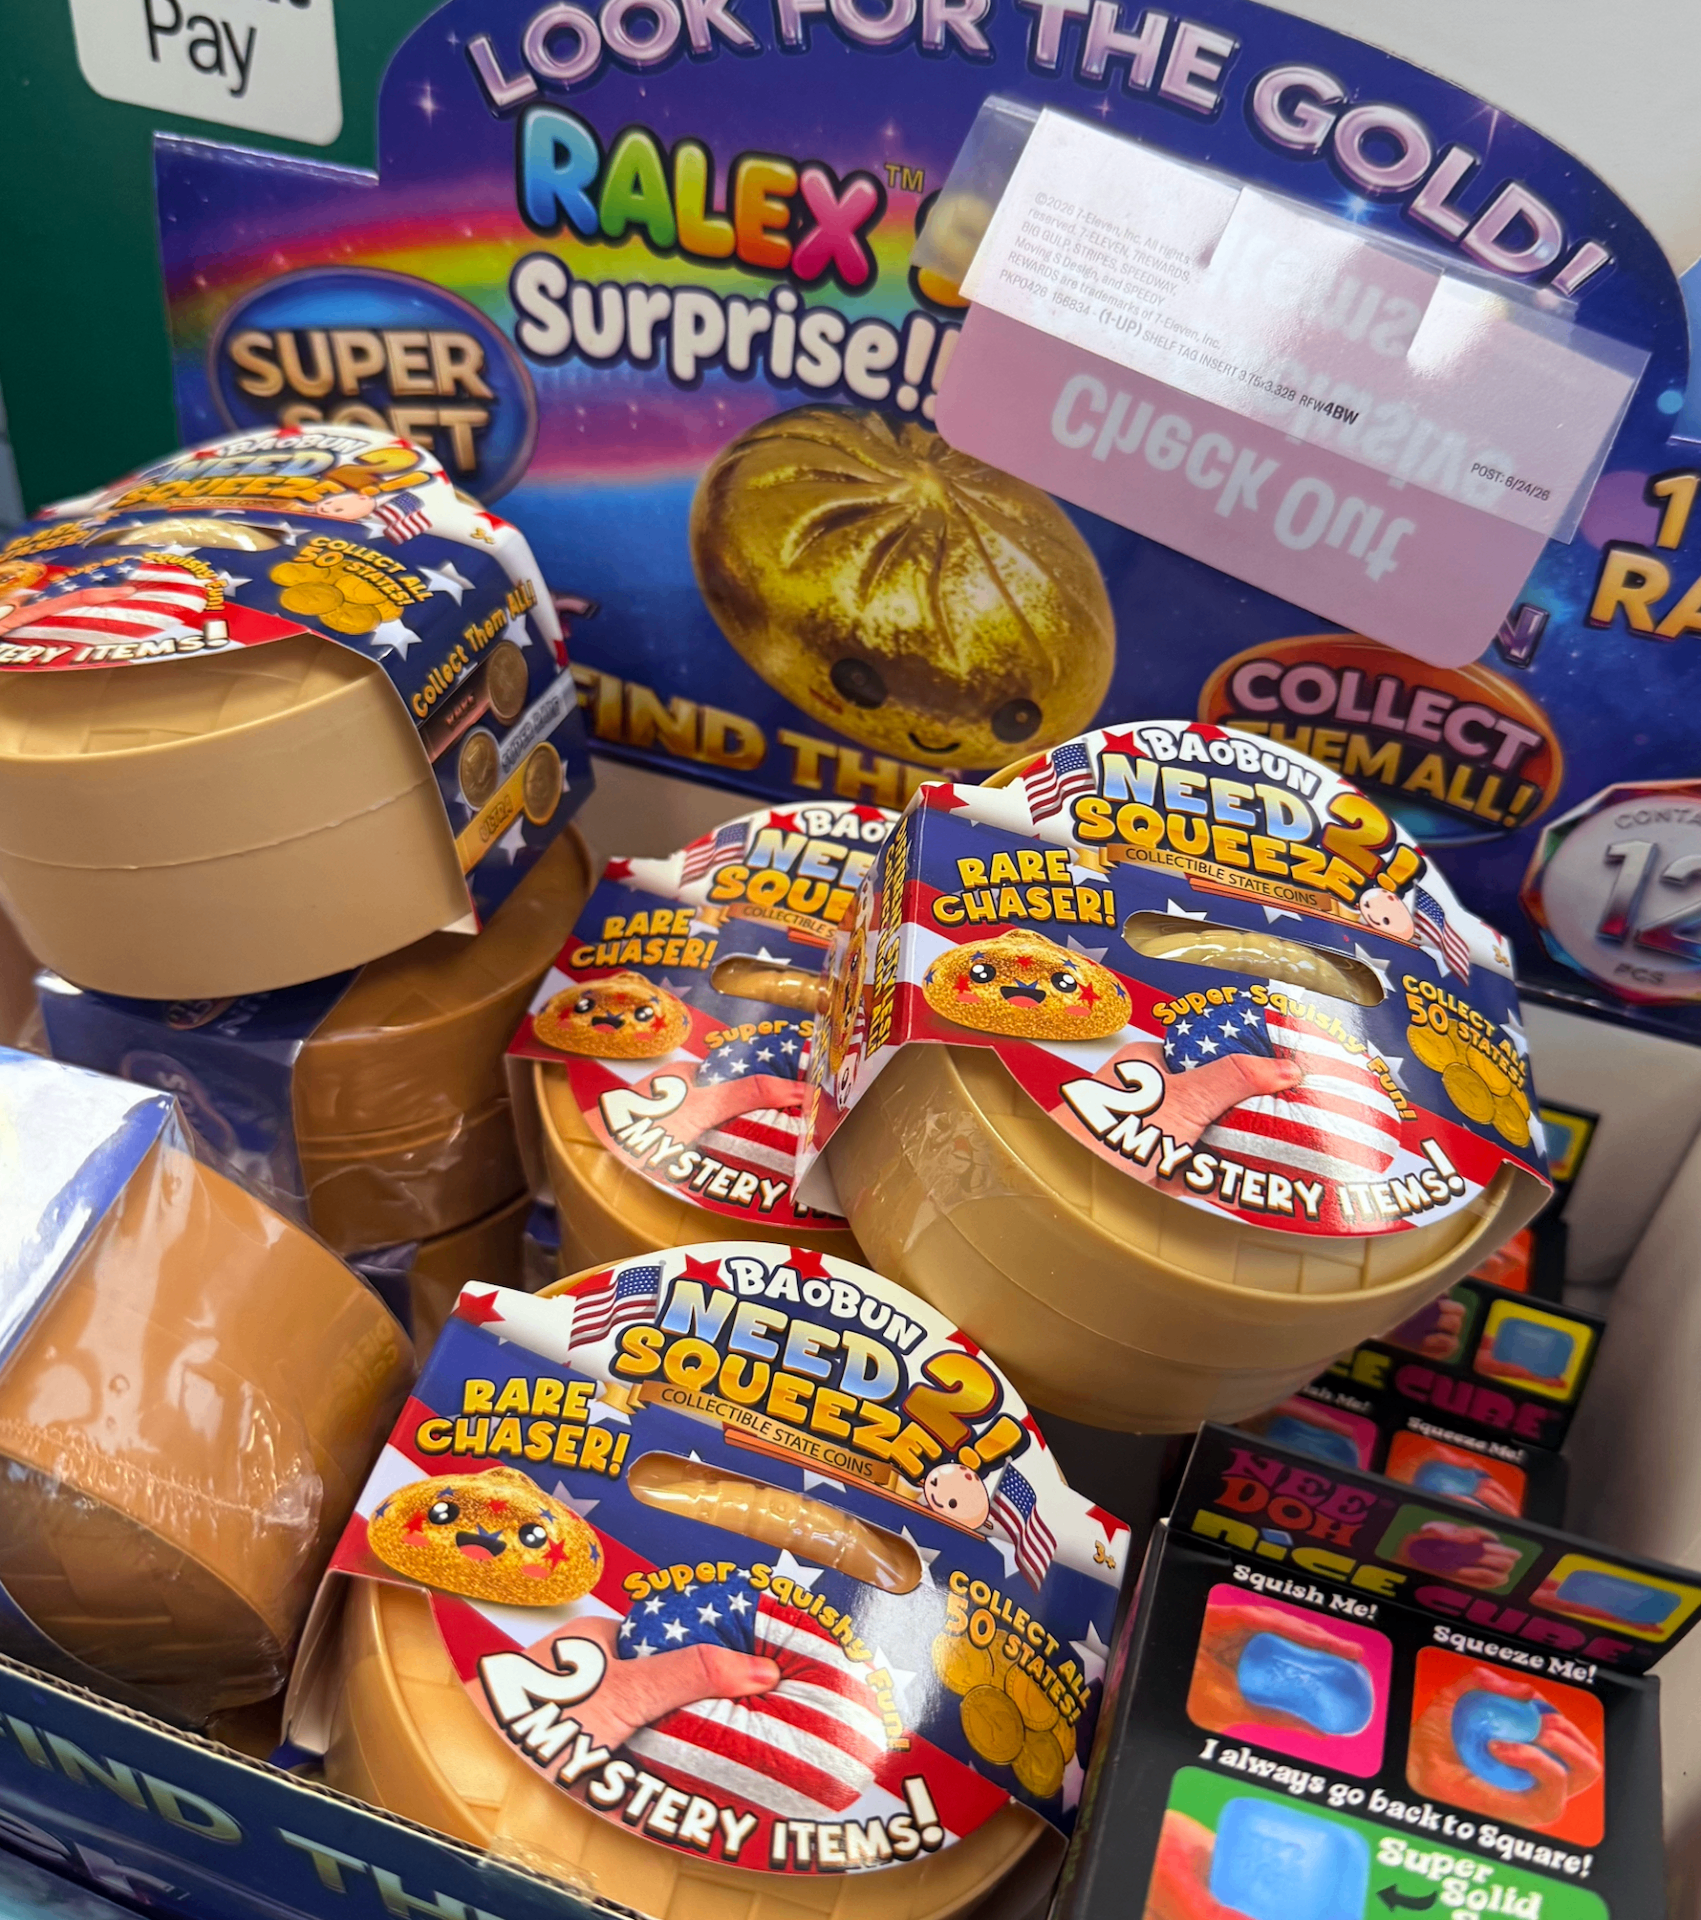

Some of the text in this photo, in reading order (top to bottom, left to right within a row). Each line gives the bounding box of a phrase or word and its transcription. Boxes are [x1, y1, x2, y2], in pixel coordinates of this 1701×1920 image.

[143, 0, 257, 98] Pay
[467, 0, 1612, 296] LOOK FOR THE GOLD!
[523, 108, 878, 287] RALEX
[1021, 221, 1039, 238] BIG
[1008, 251, 1059, 281] REWARDS
[1060, 275, 1078, 290] are
[1080, 281, 1140, 316] trademarks
[1141, 309, 1154, 321] of
[1015, 236, 1050, 263] Moving
[1101, 274, 1122, 290] and
[1123, 282, 1165, 307] SPEEDY
[230, 330, 493, 398] SUPER
[1098, 308, 1144, 338] (1-UP)
[1142, 330, 1178, 353] SHELF
[1178, 344, 1197, 361] TAG
[1199, 353, 1239, 378] INSERT
[1470, 462, 1551, 501] POST: 6/24/26
[294, 547, 415, 606] 50 STATES!
[310, 536, 434, 603] COLLECT ALL
[1590, 549, 1701, 641] RA
[72, 620, 228, 663] ITEMS!
[412, 645, 469, 718] Collect
[464, 608, 510, 652] Them
[1232, 661, 1540, 771] COLLECT
[1102, 753, 1313, 841] NEED
[1402, 754, 1535, 827] ALL!
[746, 828, 876, 890] NEE
[957, 850, 1071, 889] RARE
[1074, 792, 1423, 902] SQUEEZE 2!
[1125, 847, 1319, 906] COLLECTIBLE STATE COINS
[603, 909, 696, 940] RARE
[711, 866, 855, 922] SQUE
[743, 904, 824, 933] COLLECTIBLE
[931, 887, 1117, 928] CHASER!
[570, 938, 718, 971] CHASER!
[704, 1020, 789, 1049] Super
[1152, 986, 1238, 1025] Super
[1250, 984, 1367, 1054] Squishy
[1402, 974, 1526, 1077] COLLECT ALL
[1406, 993, 1525, 1089] 50 STATES!
[599, 1075, 689, 1135] 2
[1061, 1060, 1165, 1134] 2
[615, 1117, 790, 1214] MYSTERY
[1109, 1114, 1466, 1223] MYSTERY ITEMS!
[660, 1280, 899, 1399] NEED
[463, 1377, 596, 1422] RARE
[616, 1327, 1023, 1477] SQUEEZE 2!
[661, 1387, 874, 1475] COLLECTIBLE STATE COINS
[416, 1417, 631, 1478] CHASER!
[1214, 1477, 1363, 1548] DOH
[1093, 1540, 1116, 1569] 3+
[623, 1561, 736, 1600] Super
[750, 1563, 872, 1663] Squishy
[1233, 1563, 1378, 1621] Squish Me!
[945, 1593, 1082, 1727] 50 STATES!
[949, 1570, 1092, 1711] COLLECT ALL
[1433, 1625, 1599, 1685] Squeeze Me!
[480, 1637, 604, 1722] 2
[0, 1713, 243, 1842] IND
[277, 1828, 512, 1920] TH
[511, 1700, 944, 1871] MYSTERY ITEMS!
[1199, 1738, 1594, 1879] I always go back to Square!
[1376, 1837, 1494, 1883] Super
[1439, 1877, 1543, 1920] Solid
